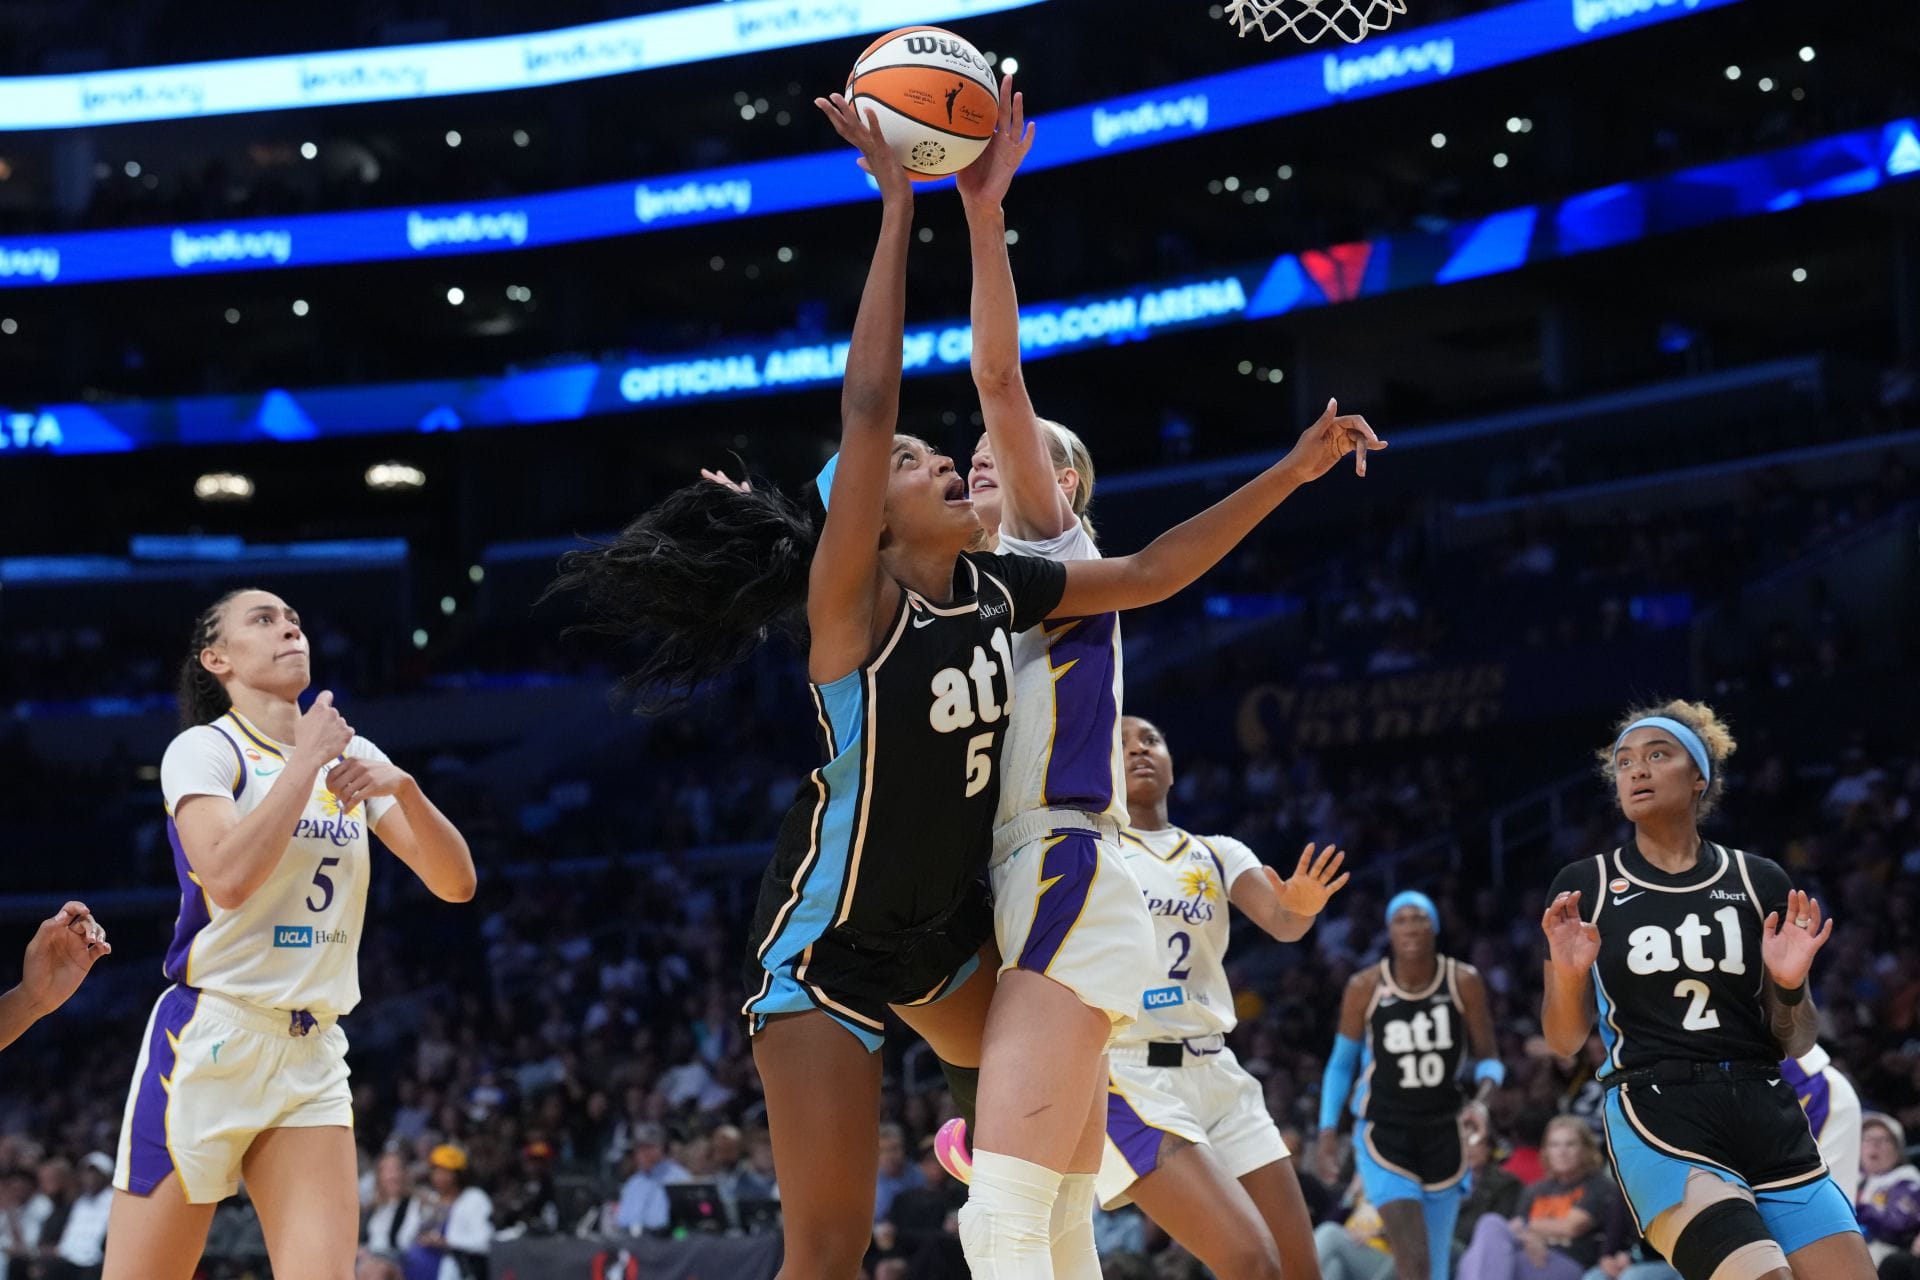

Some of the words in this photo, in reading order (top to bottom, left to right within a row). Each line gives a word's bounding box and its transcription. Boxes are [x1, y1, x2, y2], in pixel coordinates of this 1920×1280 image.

[904, 36, 995, 87] Wilson
[620, 354, 760, 402] OFFICIAL
[1139, 276, 1246, 327] ARENA
[979, 601, 1009, 620] Albert
[965, 731, 995, 798] 5
[292, 811, 360, 847] PARKS
[305, 857, 340, 912] 5
[1143, 889, 1215, 926] PARKS
[1709, 889, 1747, 902] Albert
[279, 931, 309, 944] UCLA
[1168, 931, 1192, 980] 2
[1627, 905, 1746, 976] atl
[1147, 991, 1179, 1006] UCLA
[1673, 978, 1720, 1031] 2
[1383, 1003, 1454, 1054] atl
[1397, 1052, 1446, 1088] 10
